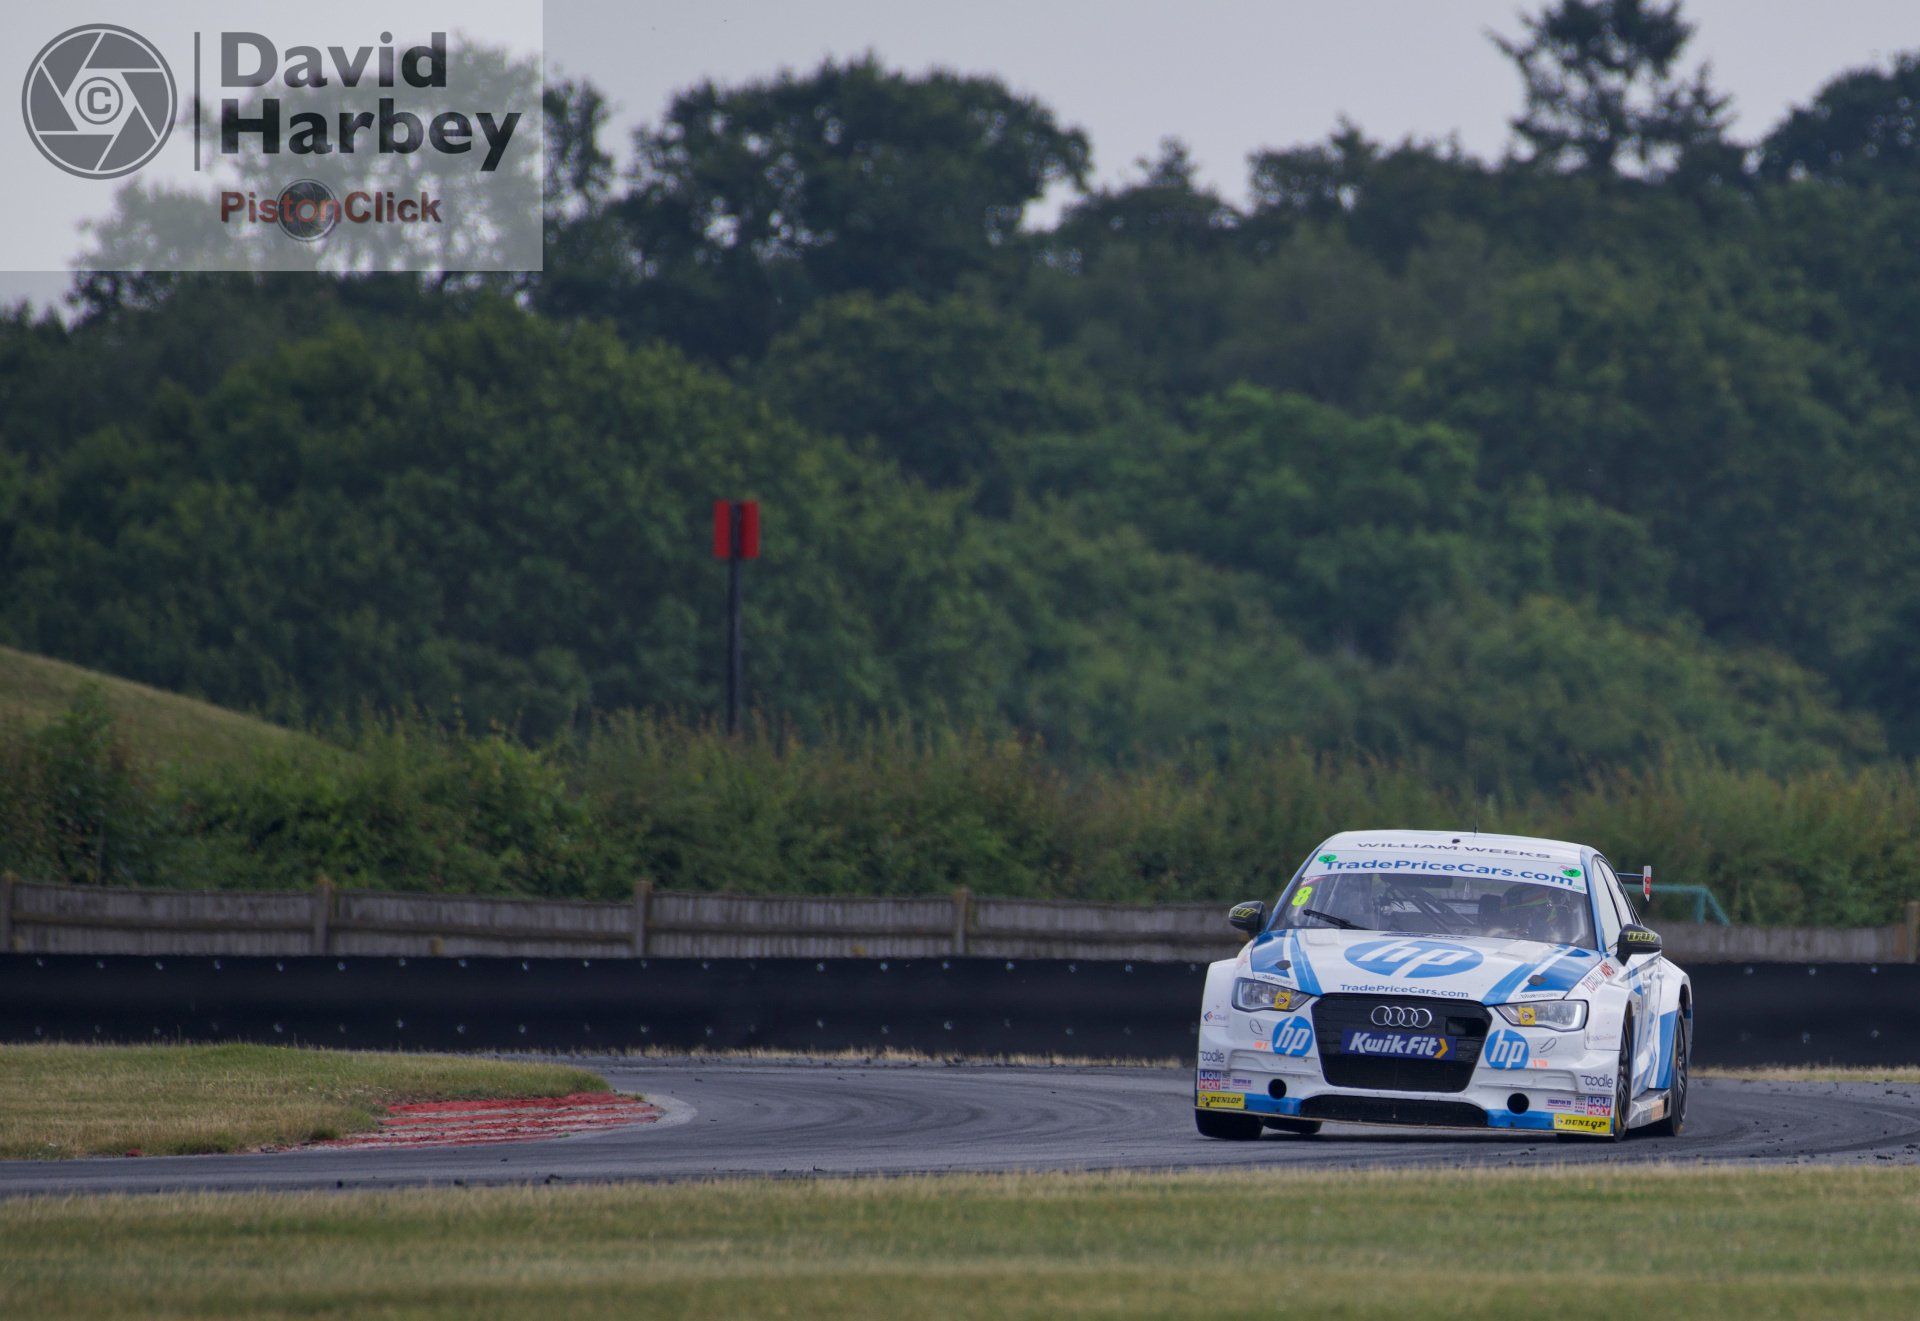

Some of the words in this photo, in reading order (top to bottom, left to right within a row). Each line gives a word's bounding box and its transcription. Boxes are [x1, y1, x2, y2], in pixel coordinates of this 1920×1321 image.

[1357, 842, 1458, 851] WILLIAM
[1464, 846, 1550, 859] WEEKS
[1325, 859, 1573, 887] TradePriceCars.com
[1291, 886, 1313, 907] 8
[1356, 940, 1475, 978] hp
[1340, 984, 1469, 998] TradePriceCars.com
[1273, 1016, 1312, 1056] hp
[1488, 1029, 1527, 1069] hp
[1200, 1071, 1220, 1080] LIQUI
[1200, 1080, 1220, 1089] MOLY
[1210, 1096, 1242, 1104] DUNLOP
[1588, 1096, 1611, 1106] LIQUI
[1588, 1106, 1610, 1116] MOLY
[1564, 1119, 1606, 1128] DUNLOP
